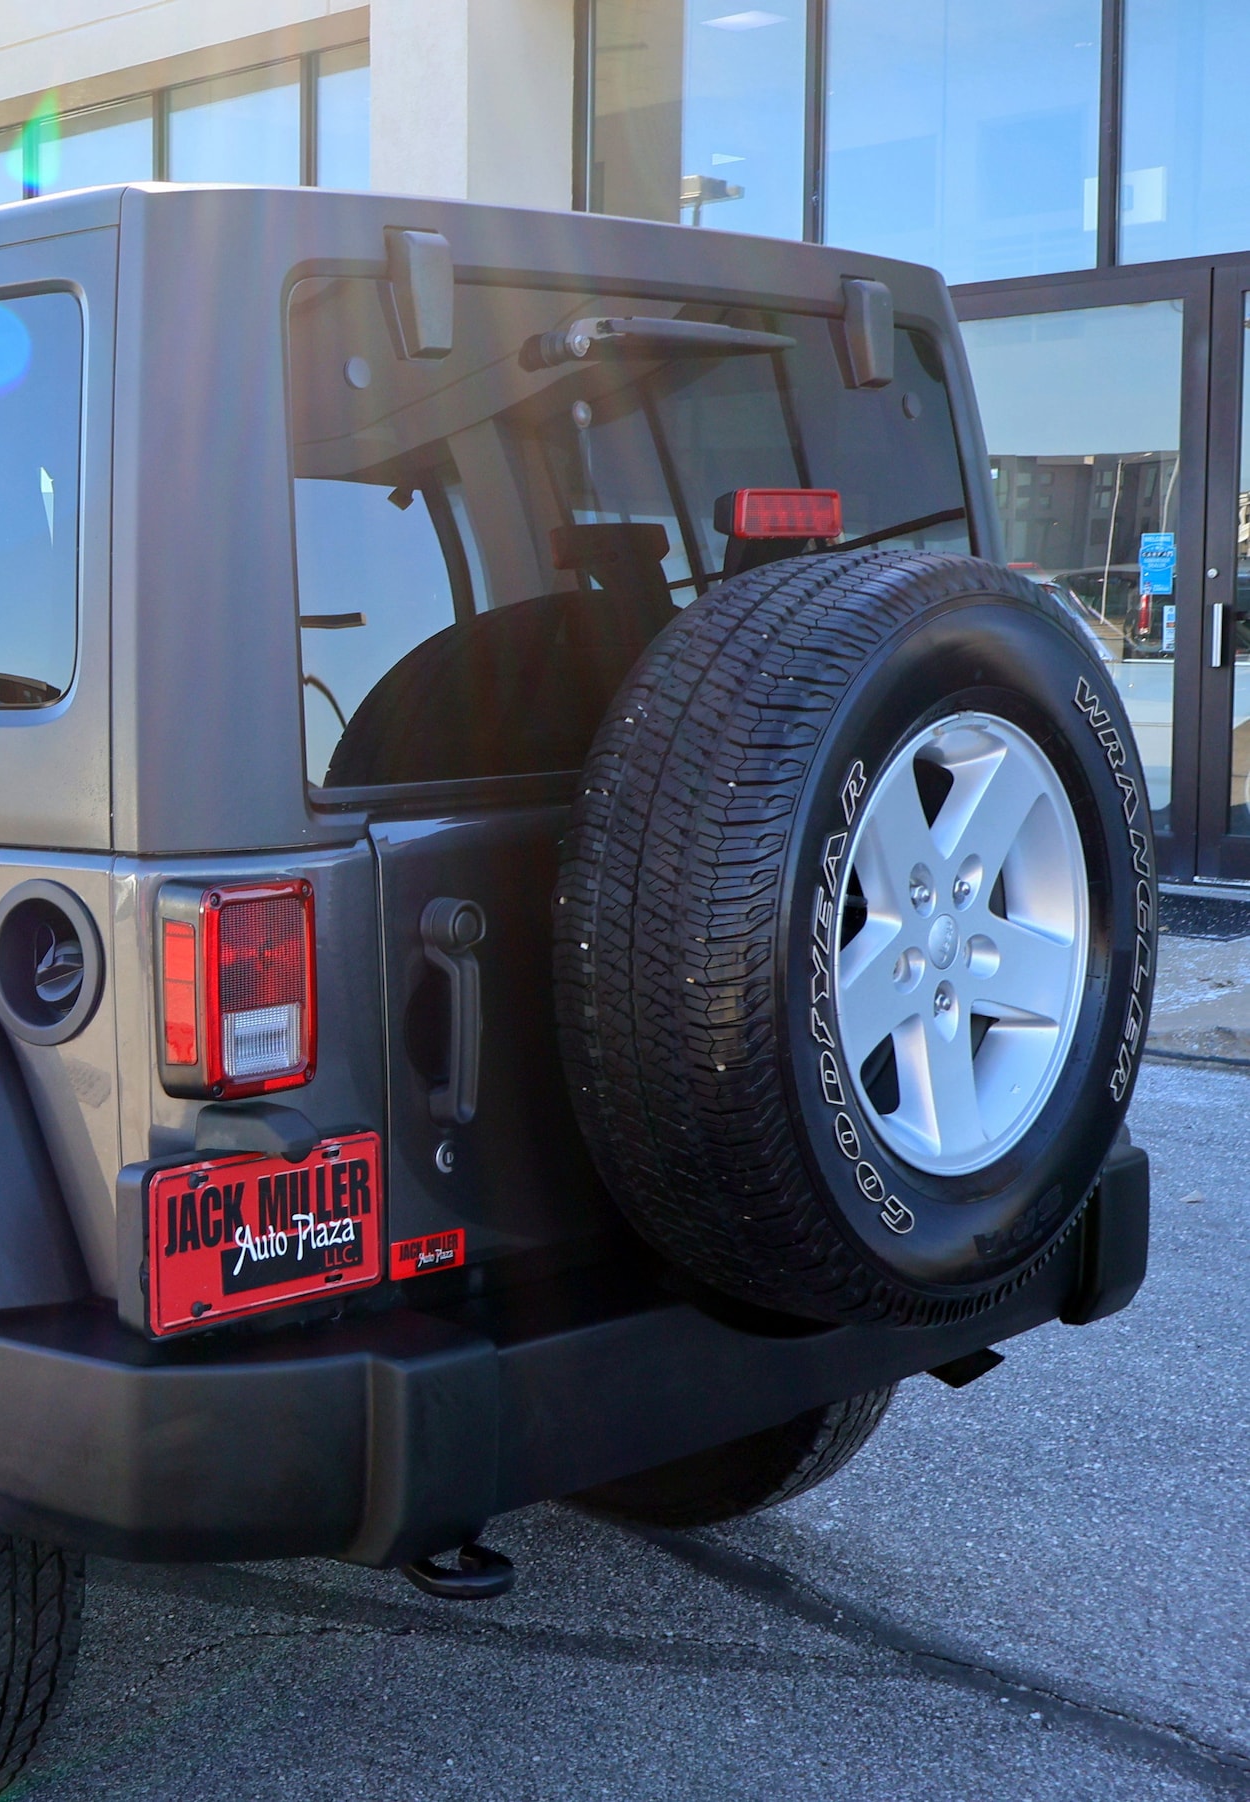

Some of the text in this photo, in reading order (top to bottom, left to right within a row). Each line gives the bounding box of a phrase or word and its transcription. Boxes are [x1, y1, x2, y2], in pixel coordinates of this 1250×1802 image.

[1073, 676, 1151, 1103] WRANGLER
[810, 759, 916, 1235] GOODYEAR
[165, 1159, 371, 1258] JACK MILLER
[232, 1213, 356, 1276] Auto Plaza
[399, 1233, 458, 1261] JACK MILLER
